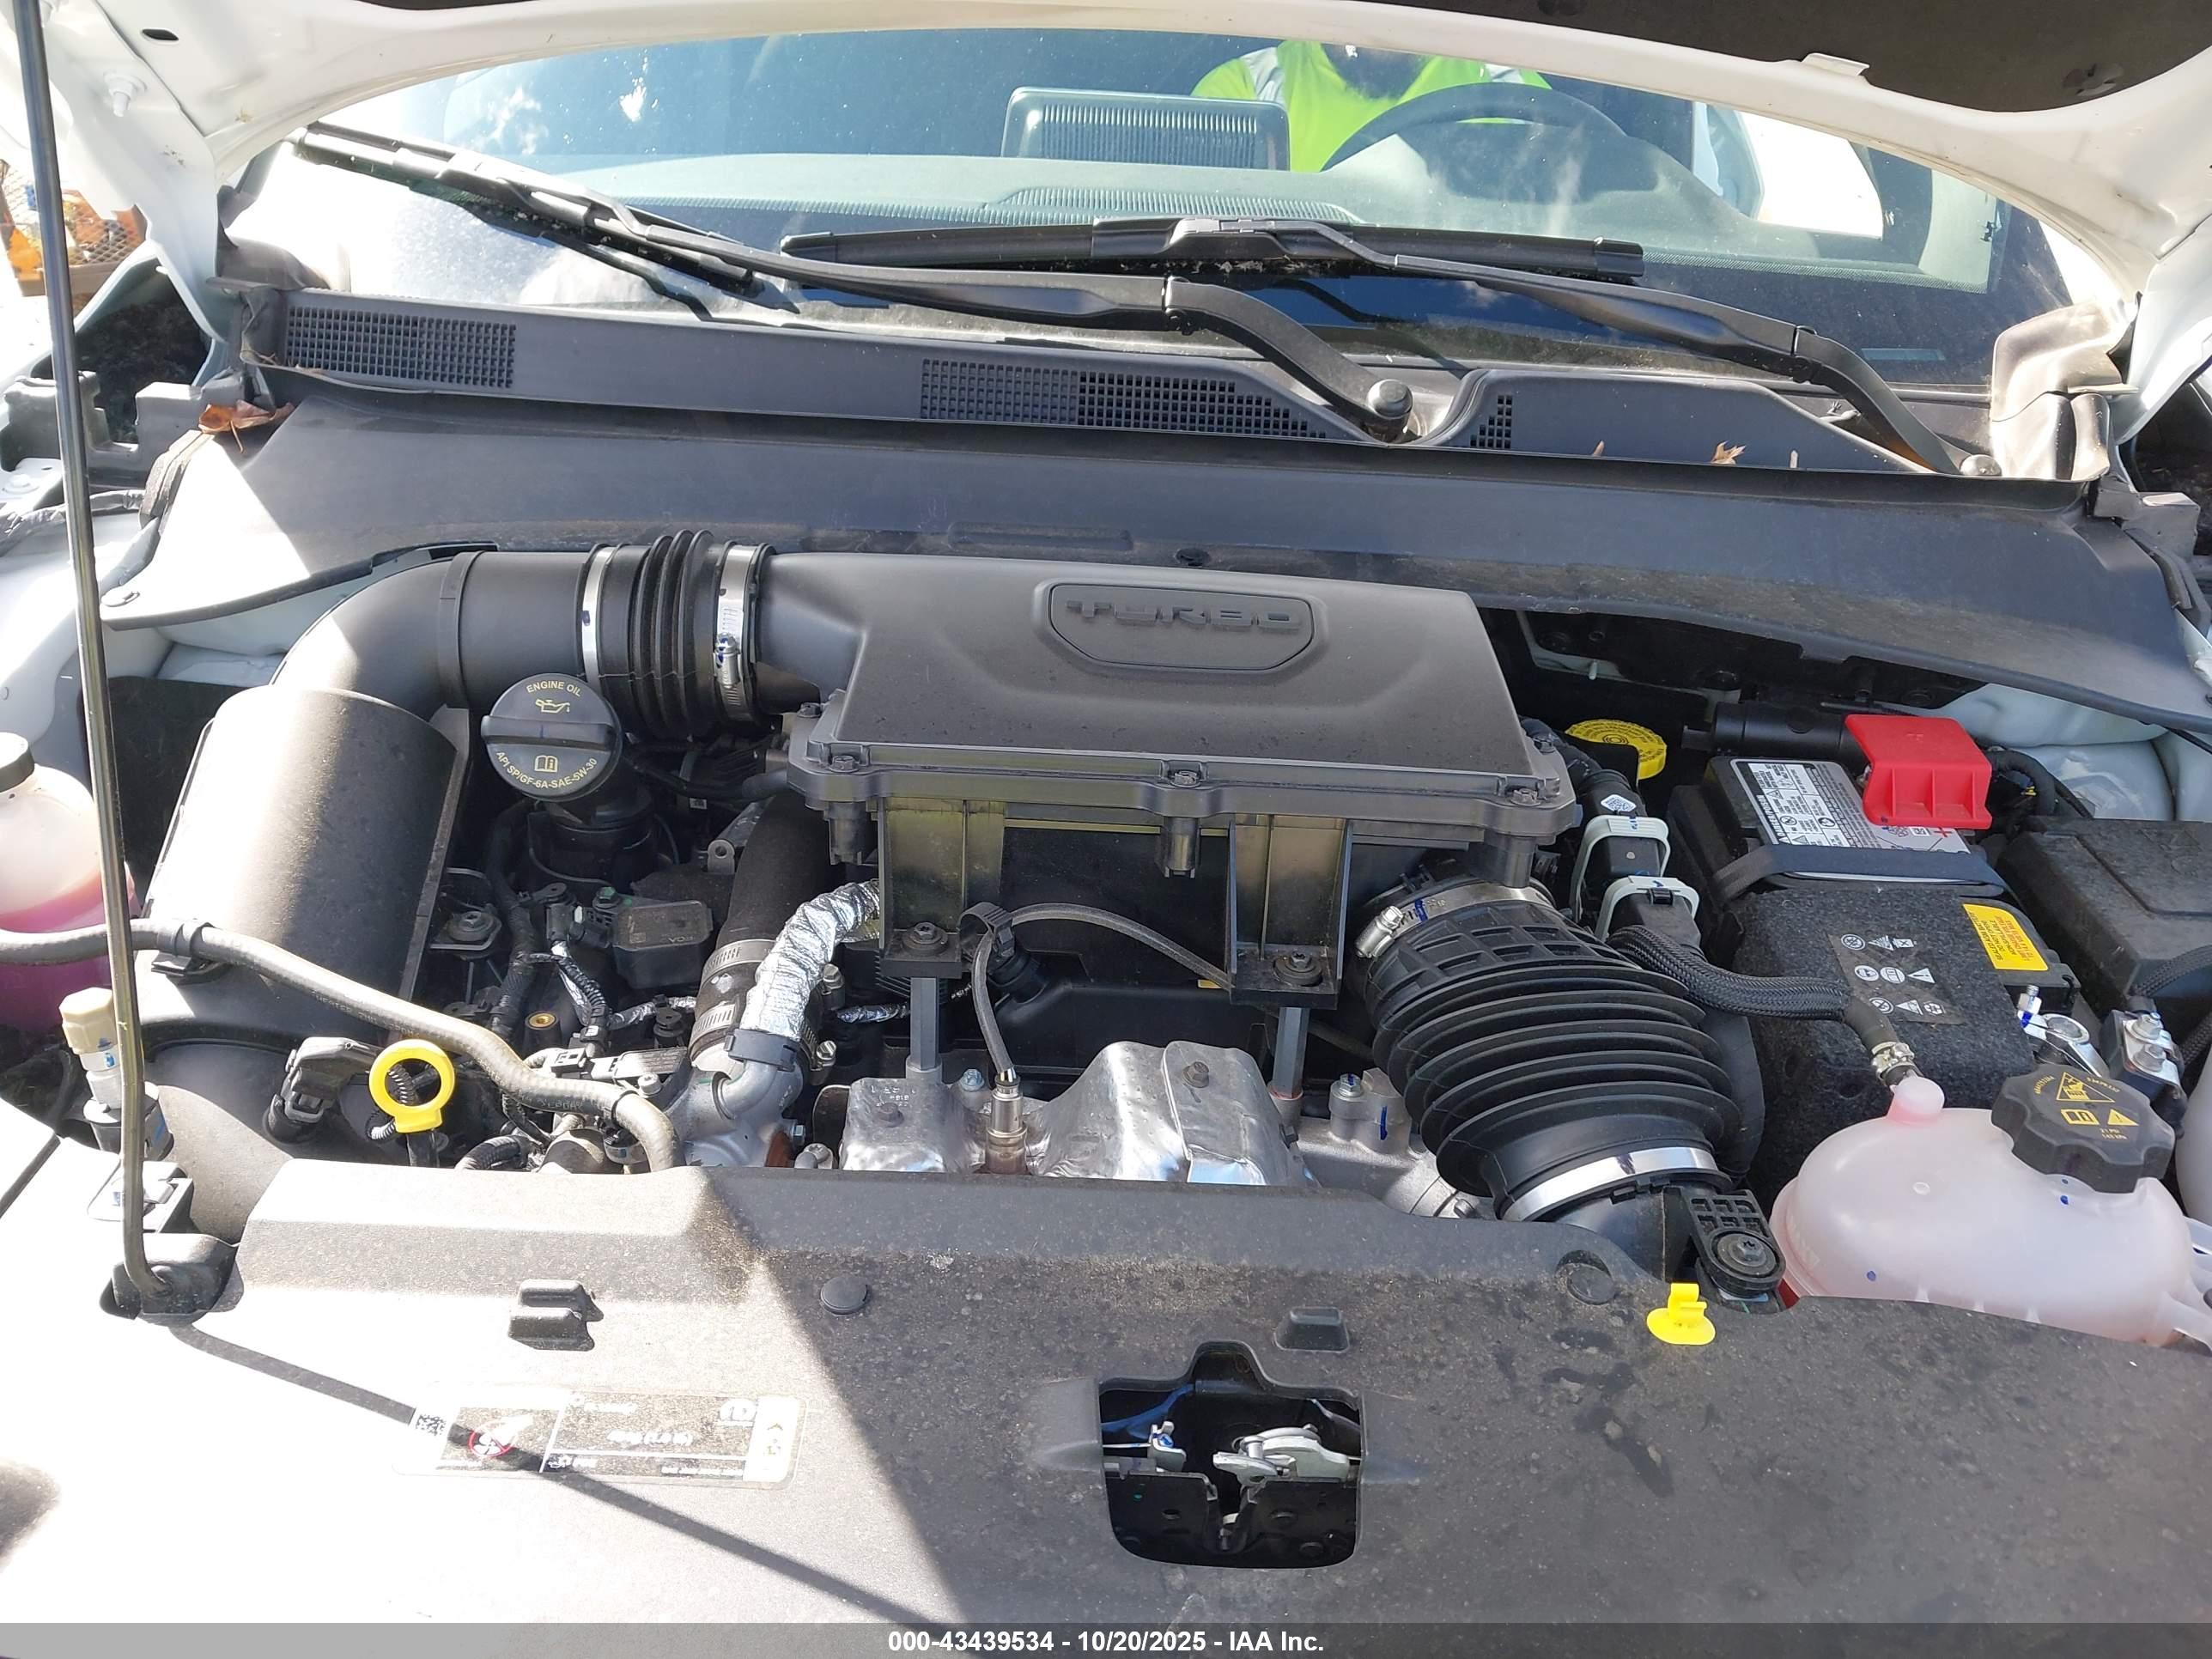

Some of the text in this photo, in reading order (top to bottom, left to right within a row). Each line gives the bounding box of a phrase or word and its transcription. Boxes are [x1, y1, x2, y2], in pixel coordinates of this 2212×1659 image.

[1066, 599, 1301, 631] TURBO
[526, 680, 583, 697] ENGINE OIL
[495, 750, 510, 768] API
[1755, 793, 1786, 836] DANGER/POISON
